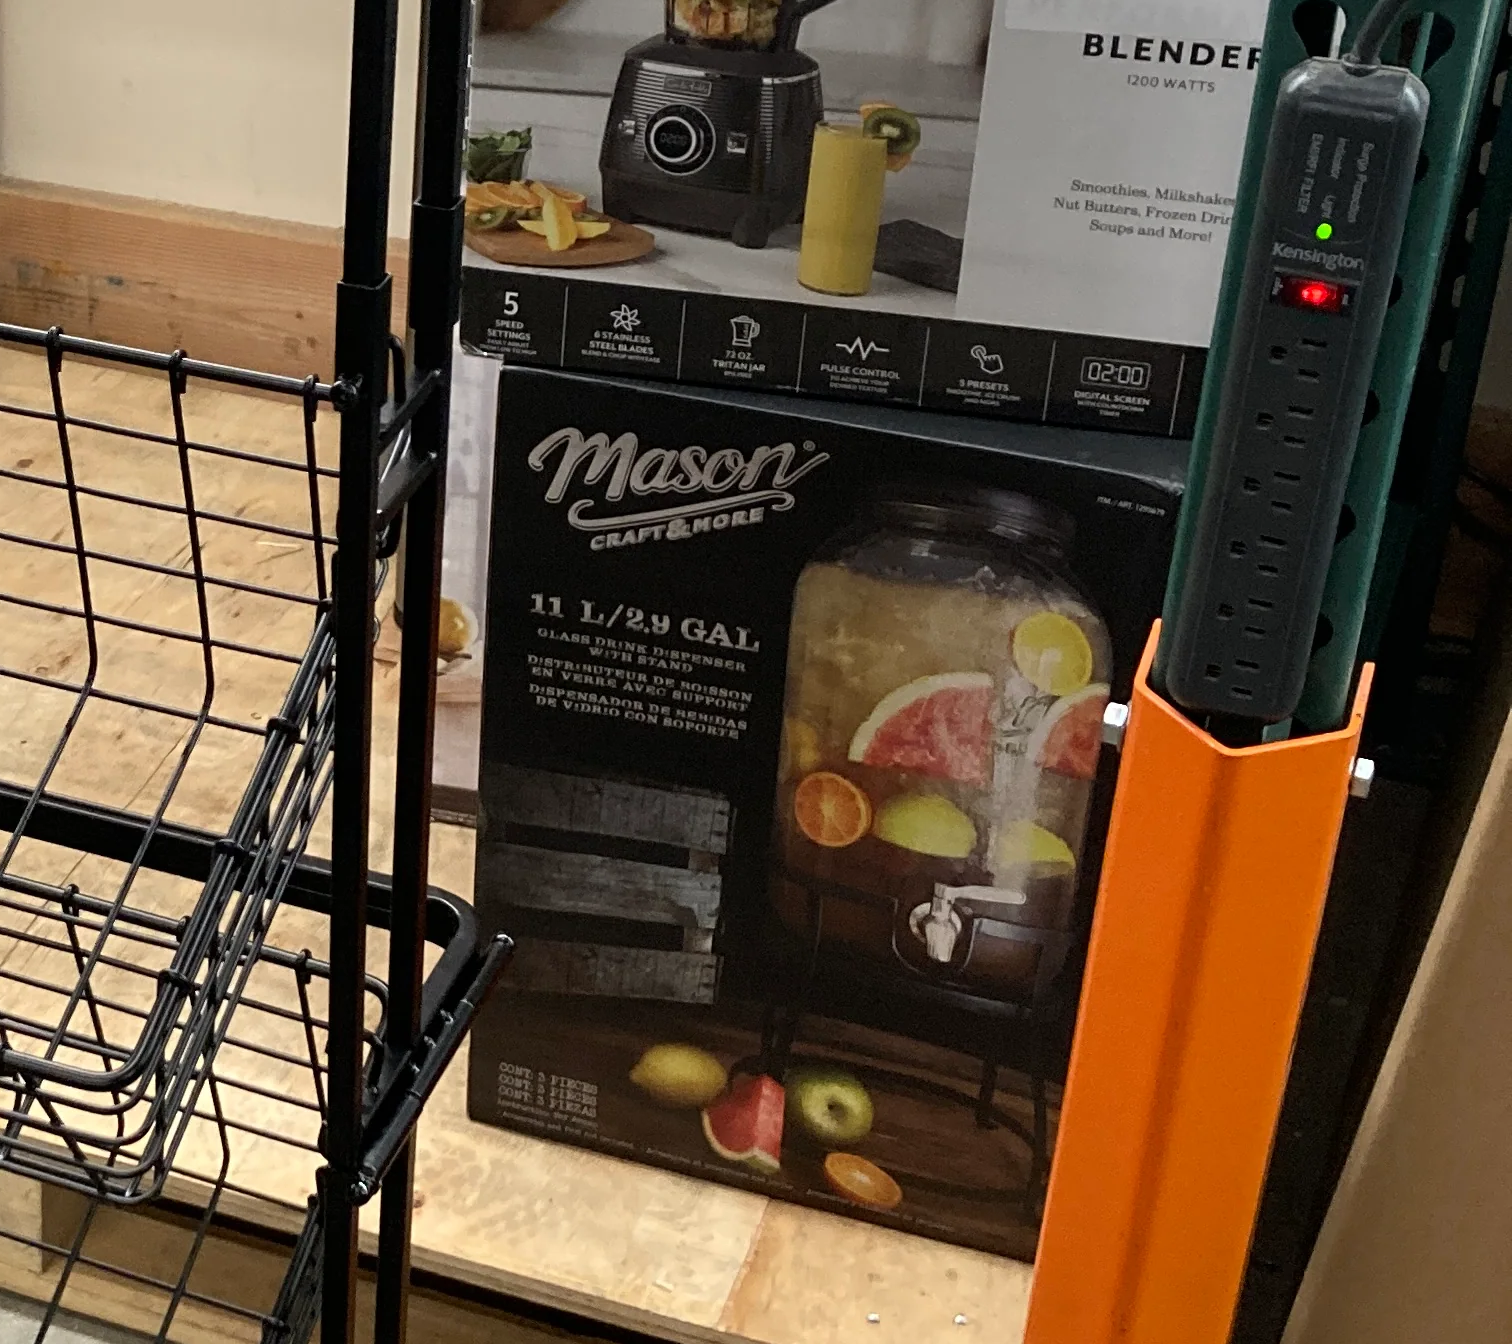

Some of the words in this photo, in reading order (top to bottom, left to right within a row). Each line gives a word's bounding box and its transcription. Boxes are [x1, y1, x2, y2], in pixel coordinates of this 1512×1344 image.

[1127, 74, 1159, 88] 1200
[1164, 78, 1216, 93] WATTS
[1071, 179, 1150, 200] Smoothies,
[1297, 178, 1314, 213] FILTER
[1054, 197, 1080, 211] Nut
[1084, 200, 1141, 218] Butters,
[1145, 206, 1197, 222] Frozen
[1089, 219, 1134, 236] Soups
[1138, 226, 1164, 239] and
[1169, 230, 1212, 244] More!
[1272, 241, 1365, 271] Kensington
[503, 291, 519, 316] 5
[487, 329, 531, 341] SETTINGS
[495, 319, 524, 329] SPEED
[589, 341, 616, 351] STEEL
[618, 343, 654, 355] BLADES
[602, 331, 651, 344] STAINLESS
[712, 360, 748, 371] TRITAN
[749, 363, 766, 372] JAR
[821, 363, 851, 374] PULSE
[852, 366, 900, 380] CONTROL
[1088, 362, 1144, 386] 02:00
[967, 380, 1009, 392] PRESETS
[1074, 390, 1112, 403] DIGITAL
[1113, 394, 1151, 406] SCREEN
[527, 427, 830, 503] Mason
[530, 592, 565, 618] 11
[680, 617, 760, 653] GAL
[537, 628, 590, 645] GLASS
[594, 636, 647, 655] DRINK
[653, 646, 746, 672] DISPENSER
[589, 647, 632, 662] WITH
[638, 655, 693, 673] STAND
[527, 654, 648, 683] DISTRIBUTEUR
[653, 675, 675, 687] DE
[681, 680, 752, 703] BOISSON
[531, 666, 553, 678] EN
[561, 671, 617, 689] VERRE
[623, 682, 667, 697] AVEC
[672, 690, 748, 713] SUPPORT
[529, 683, 644, 711] DISPENSADOR
[649, 703, 671, 716] DE
[676, 709, 747, 731] BEBIDAS
[536, 695, 557, 708] DE
[563, 700, 620, 717] VIDRIO
[624, 709, 658, 725] CON
[663, 717, 739, 740] SOPORTE
[550, 1075, 598, 1095] PIECES
[549, 1098, 597, 1118] PIEZAS
